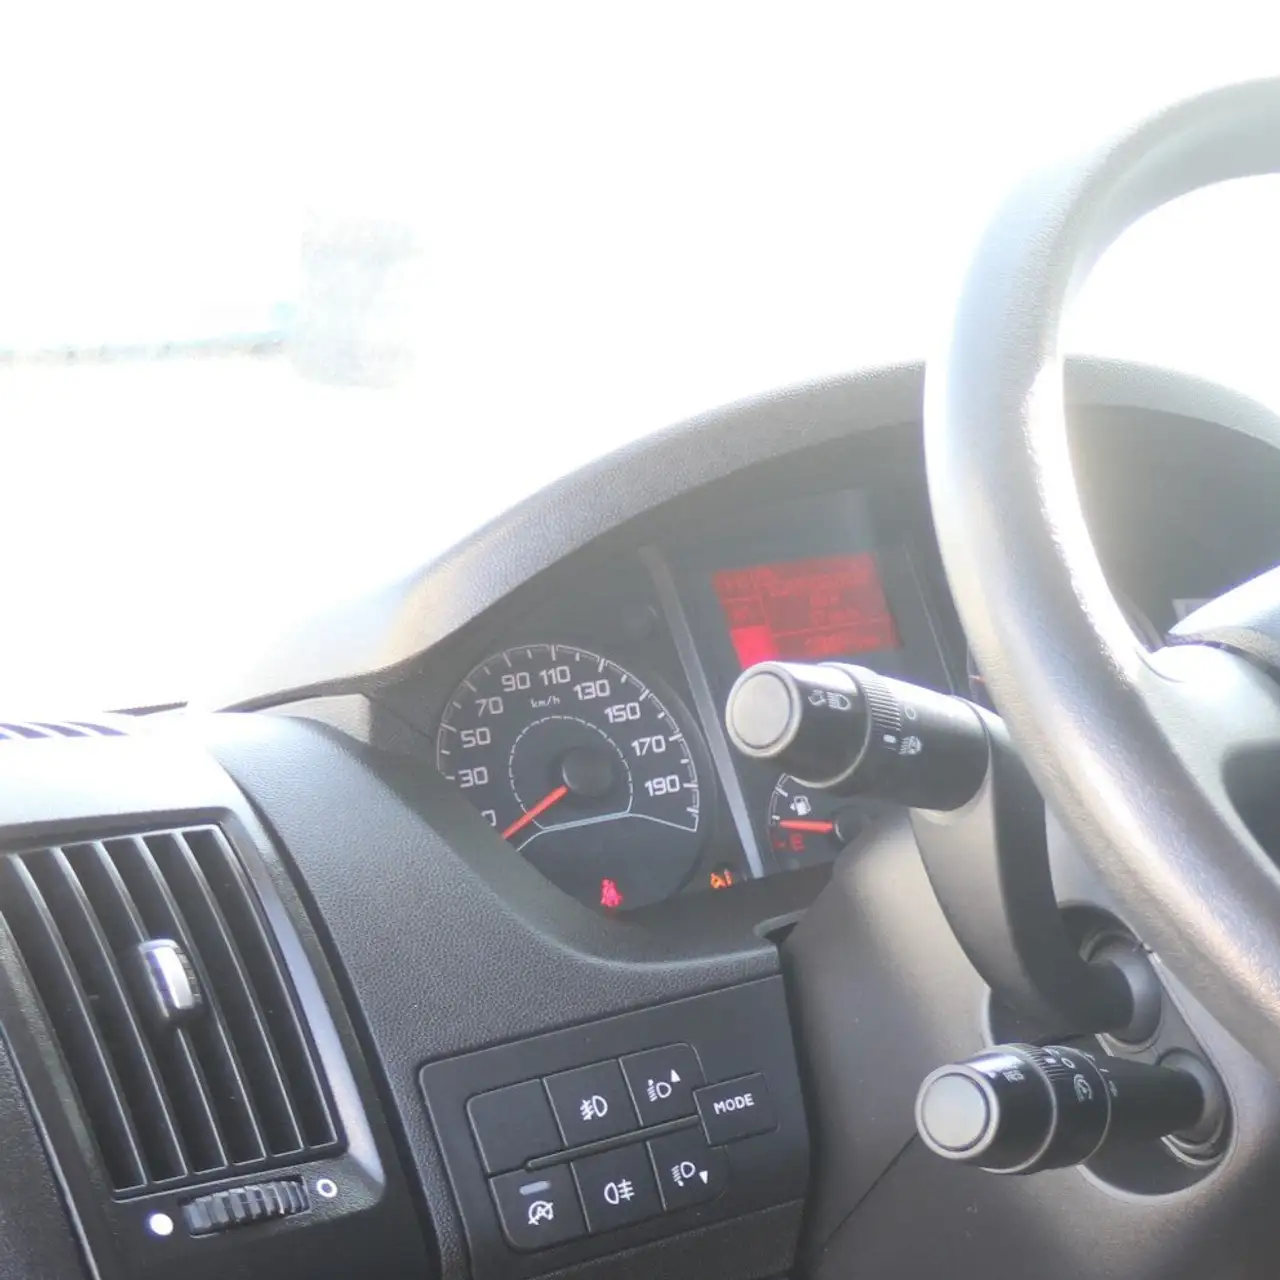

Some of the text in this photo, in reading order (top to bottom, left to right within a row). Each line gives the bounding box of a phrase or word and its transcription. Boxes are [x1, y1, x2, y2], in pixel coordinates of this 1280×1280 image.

[501, 671, 531, 692] 90
[539, 665, 571, 686] 110
[573, 679, 611, 700] 130
[475, 697, 504, 717] 70
[530, 695, 561, 709] km/h
[604, 702, 641, 723] 150
[460, 727, 491, 748] 50
[631, 735, 666, 756] 170
[458, 767, 489, 788] 30
[643, 775, 680, 796] 190
[713, 1093, 755, 1115] MODE
